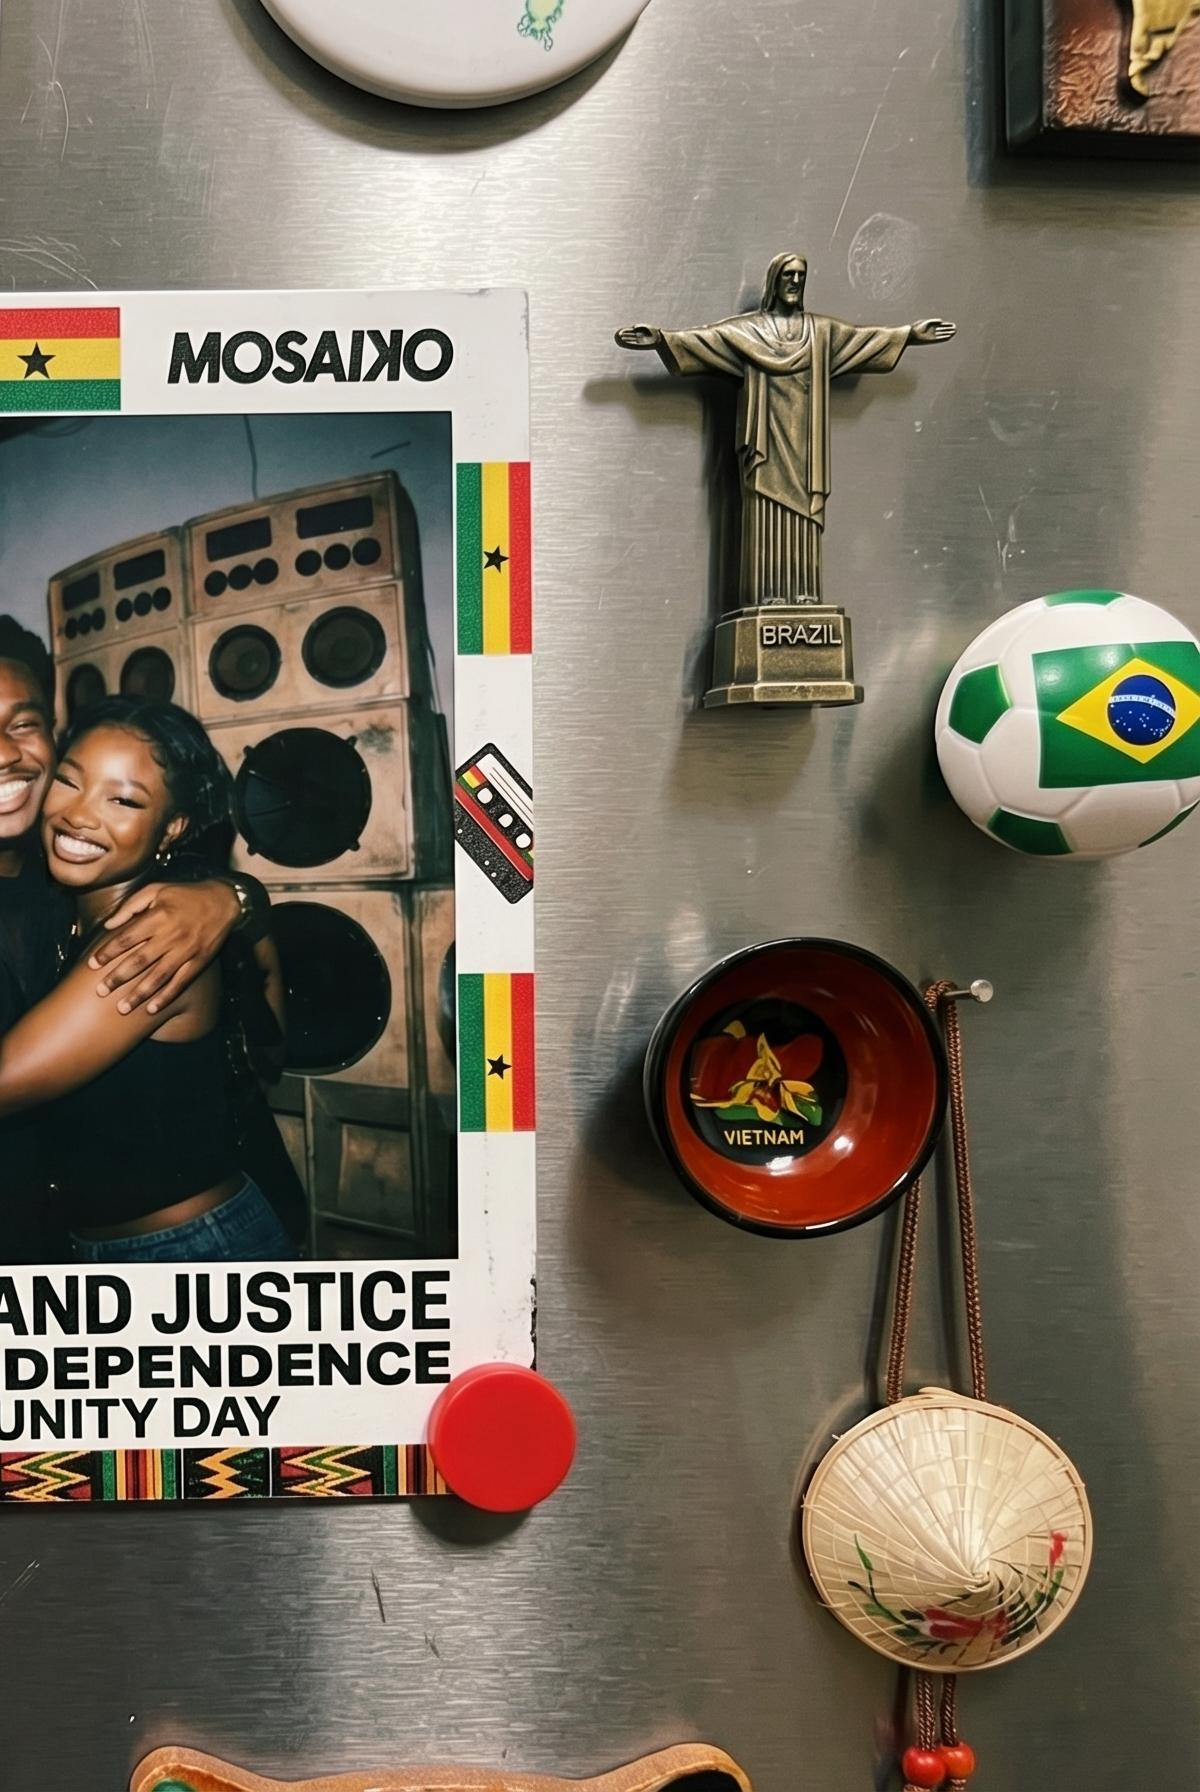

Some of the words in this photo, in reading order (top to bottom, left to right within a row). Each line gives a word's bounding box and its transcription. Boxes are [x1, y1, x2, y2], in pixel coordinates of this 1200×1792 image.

[167, 328, 454, 384] MOSAIKO
[762, 624, 842, 645] BRAZIL
[724, 1129, 804, 1146] VIETNAM
[151, 1270, 451, 1335] JUSTICE
[173, 1395, 281, 1438] DAY
